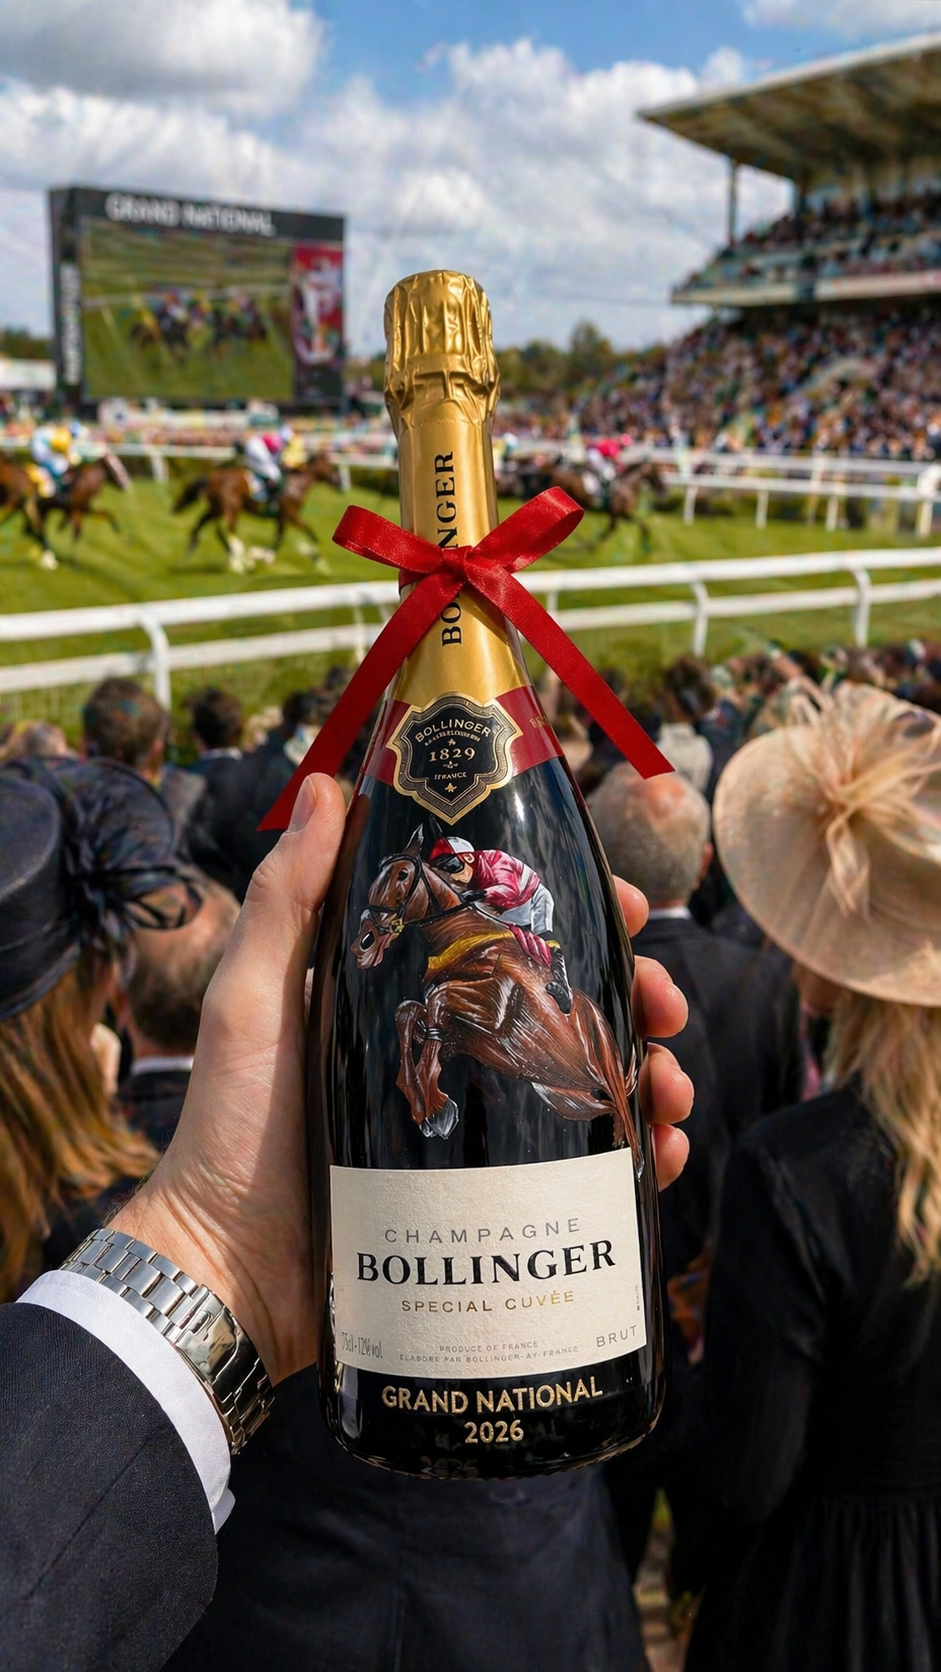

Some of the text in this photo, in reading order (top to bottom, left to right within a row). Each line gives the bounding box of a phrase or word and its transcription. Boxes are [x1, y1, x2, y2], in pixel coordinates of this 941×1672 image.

[105, 192, 278, 237] GRAND NATIONAL
[434, 451, 463, 647] BONGER
[414, 718, 492, 743] BOLLINGER
[429, 747, 476, 762] 1829
[384, 1217, 581, 1244] CHAMPAGNE
[355, 1239, 617, 1286] BOLLINGER
[401, 1290, 575, 1313] SPECIAL CUVÉE
[439, 1345, 483, 1353] PRODUCE
[486, 1344, 498, 1352] OF
[596, 1324, 637, 1348] BRUT
[381, 1376, 604, 1415] GRAND NATIONAL
[463, 1418, 525, 1445] 2026
